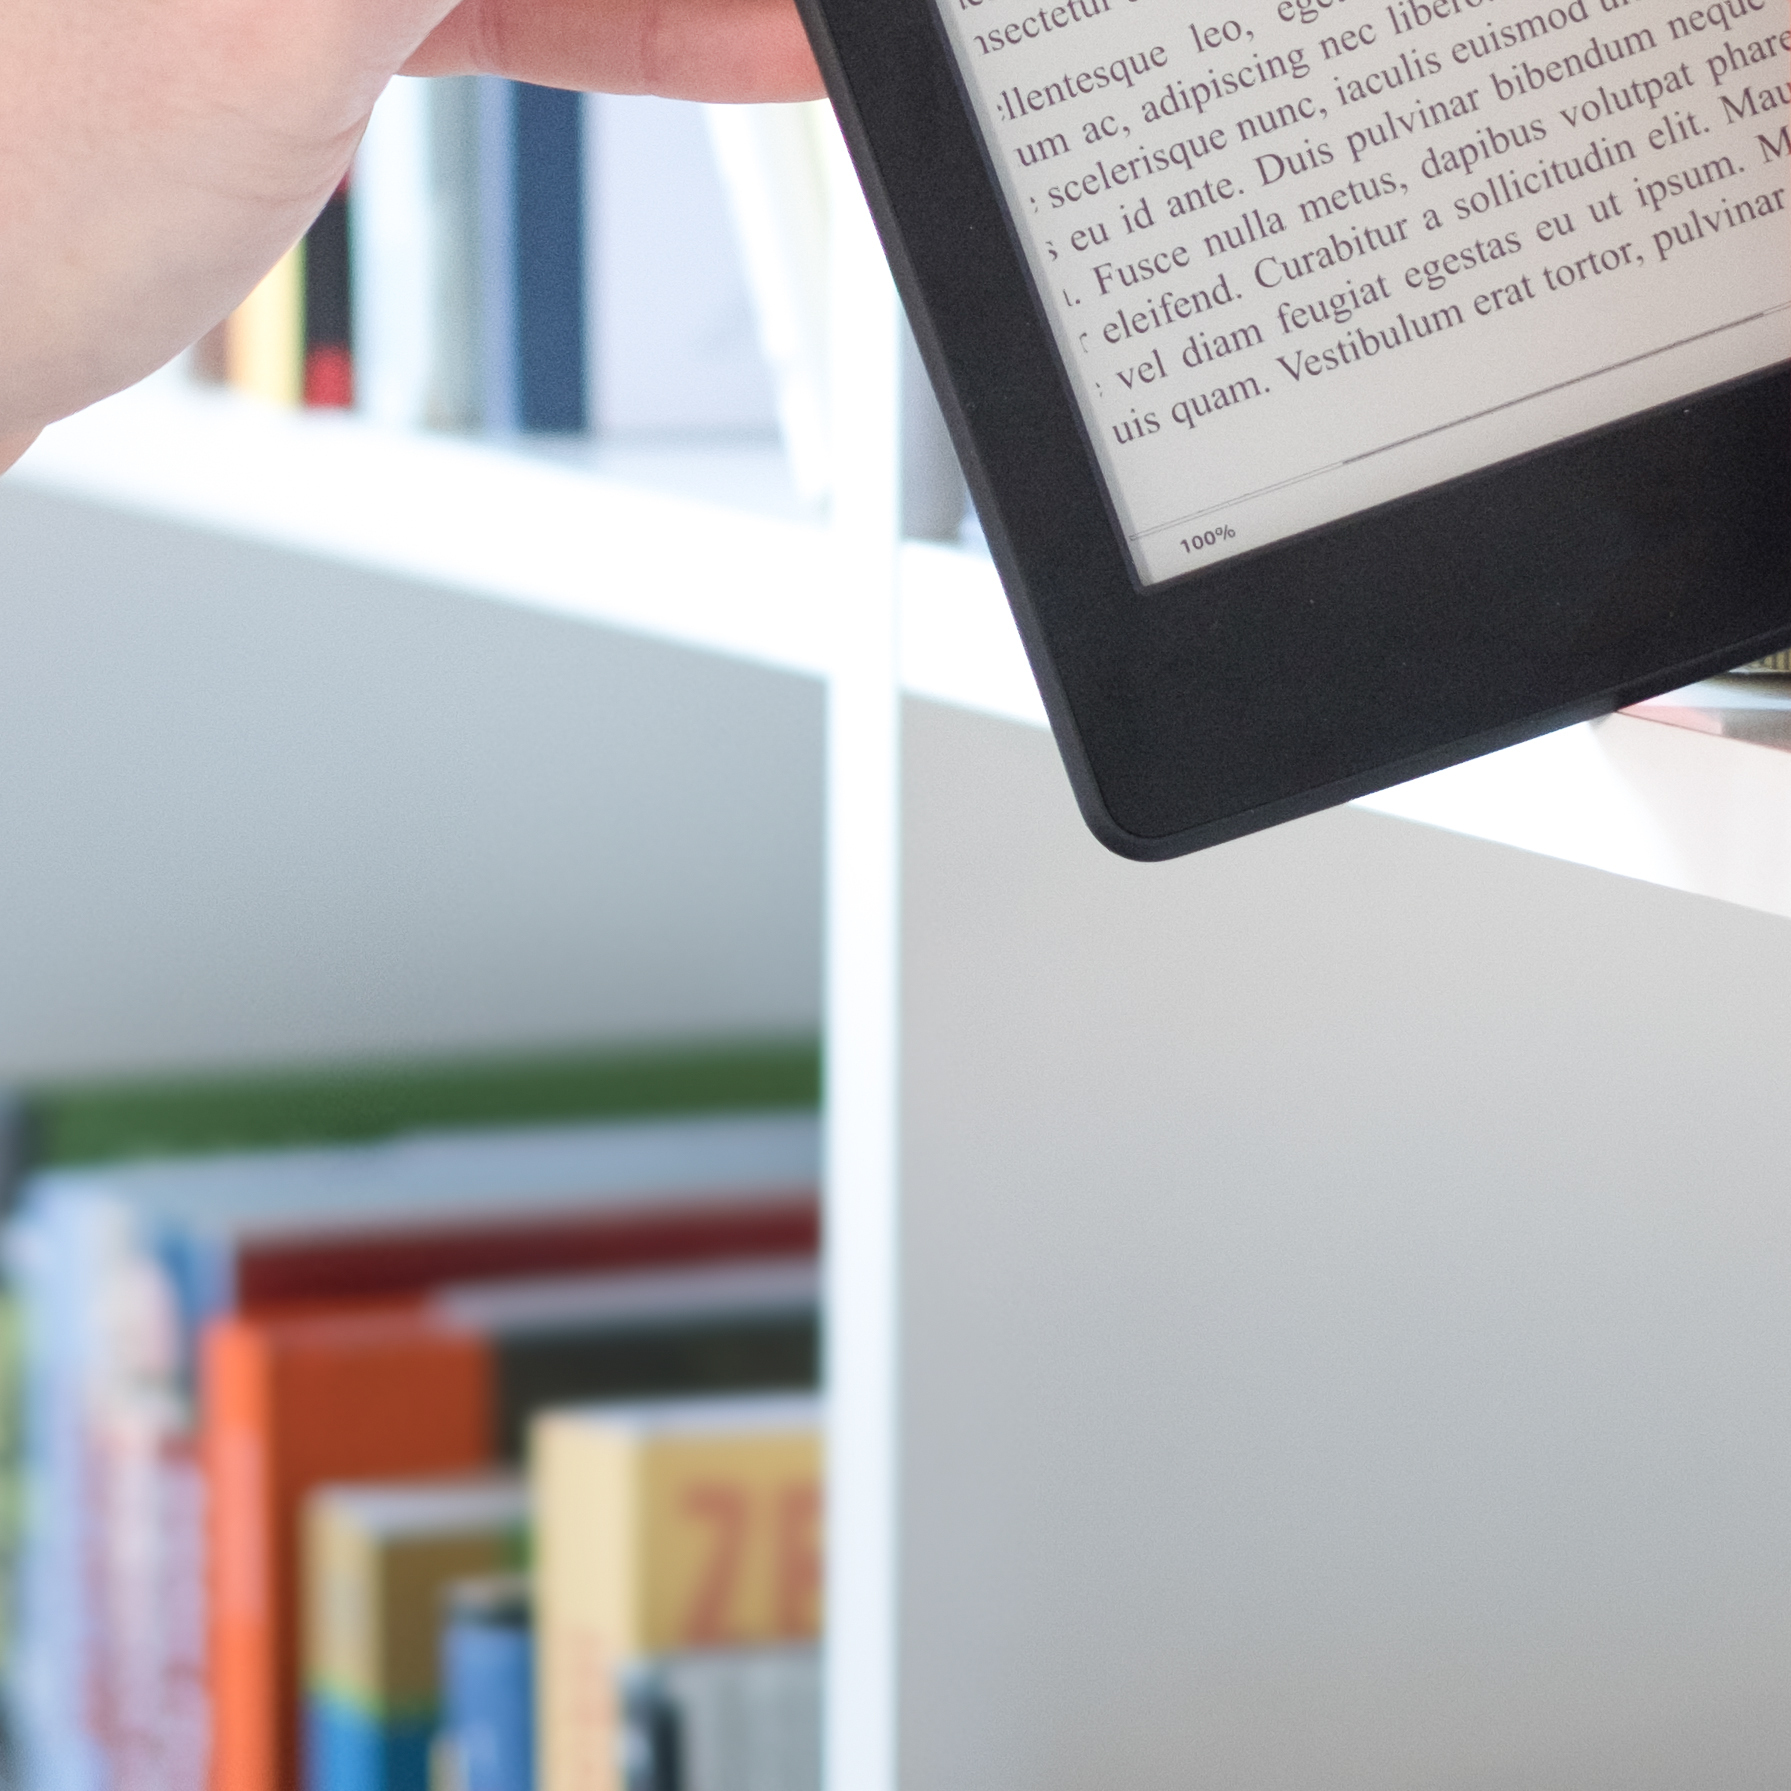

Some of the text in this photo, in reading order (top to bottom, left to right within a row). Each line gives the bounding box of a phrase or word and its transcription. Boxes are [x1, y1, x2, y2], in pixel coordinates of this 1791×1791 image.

[995, 46, 1169, 122] llentesque
[1189, 20, 1254, 53] leo,
[1015, 133, 1071, 167] um
[1082, 115, 1131, 145] ac,
[1141, 48, 1311, 124] adipiscing
[1319, 23, 1376, 60] nec
[1047, 128, 1227, 209] scelerisque
[1236, 97, 1328, 142] nunc,
[1333, 48, 1442, 106] iaculis
[1070, 223, 1110, 252] eu
[1119, 197, 1155, 234] id
[1166, 178, 1245, 218] ante.
[1254, 138, 1335, 186] Duis
[1346, 88, 1479, 163] pulvinar
[1489, 28, 1657, 101] bibendum
[1092, 246, 1190, 296] Fusce
[1203, 209, 1286, 257] nulla
[1298, 172, 1408, 223] metus,
[1421, 119, 1547, 179] dapibus
[1559, 63, 1694, 127] volutpat
[1102, 273, 1243, 344] eleifend.
[1254, 218, 1408, 289] Curabitur
[1422, 208, 1443, 231] a
[1453, 137, 1636, 220] sollicitudin
[1648, 111, 1710, 151] elit.
[1112, 188, 1785, 445] uis quam. Vestibulum erat tortor, pulvinar
[1116, 348, 1168, 389] vel
[1182, 323, 1264, 368] diam
[1277, 275, 1391, 334] feugiat
[1404, 231, 1522, 291] egestas
[1536, 213, 1576, 242] eu
[1588, 192, 1622, 224] ut
[1633, 156, 1745, 212] ipsum.
[1180, 525, 1236, 554] 100%
